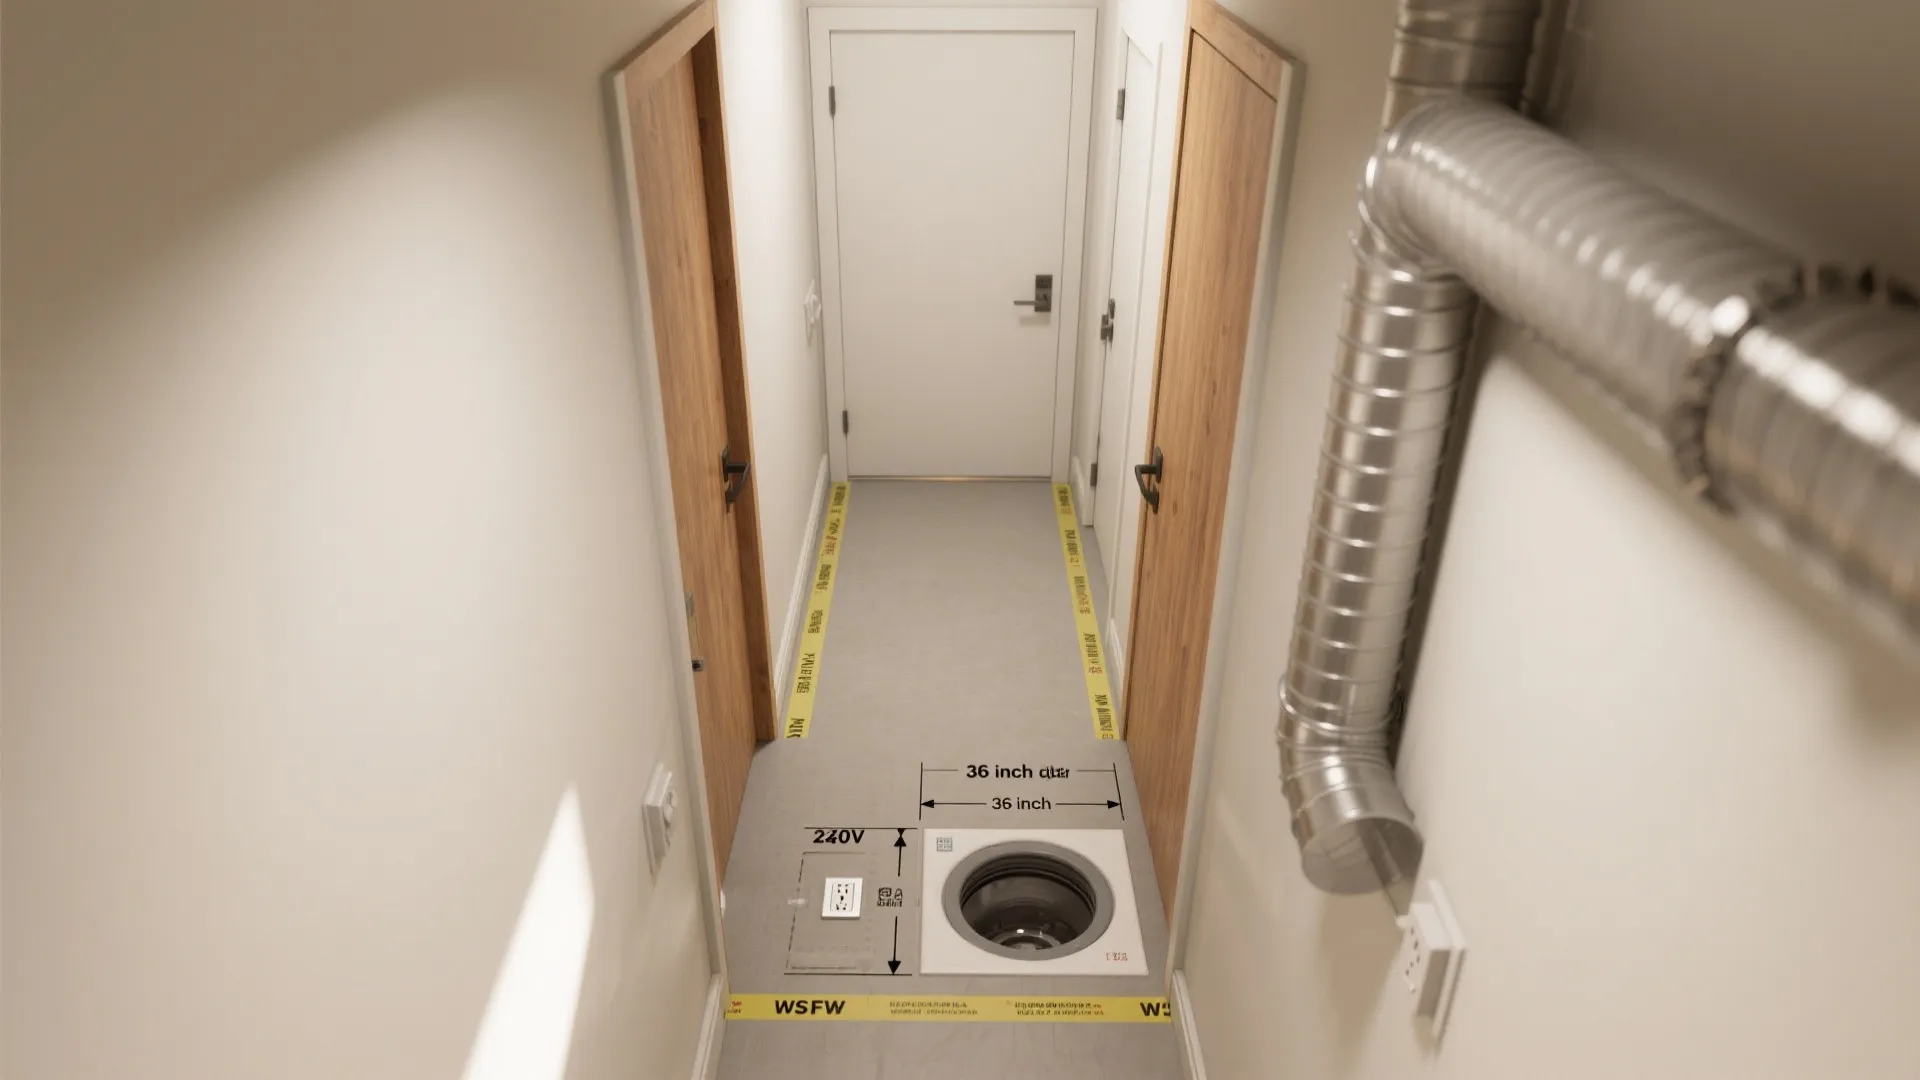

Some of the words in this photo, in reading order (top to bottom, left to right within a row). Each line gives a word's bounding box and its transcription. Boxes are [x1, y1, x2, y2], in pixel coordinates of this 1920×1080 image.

[967, 764, 989, 778] 36
[995, 764, 1033, 778] inch
[992, 797, 1012, 809] 36
[1017, 797, 1051, 809] inch
[775, 1000, 846, 1015] WSFW
